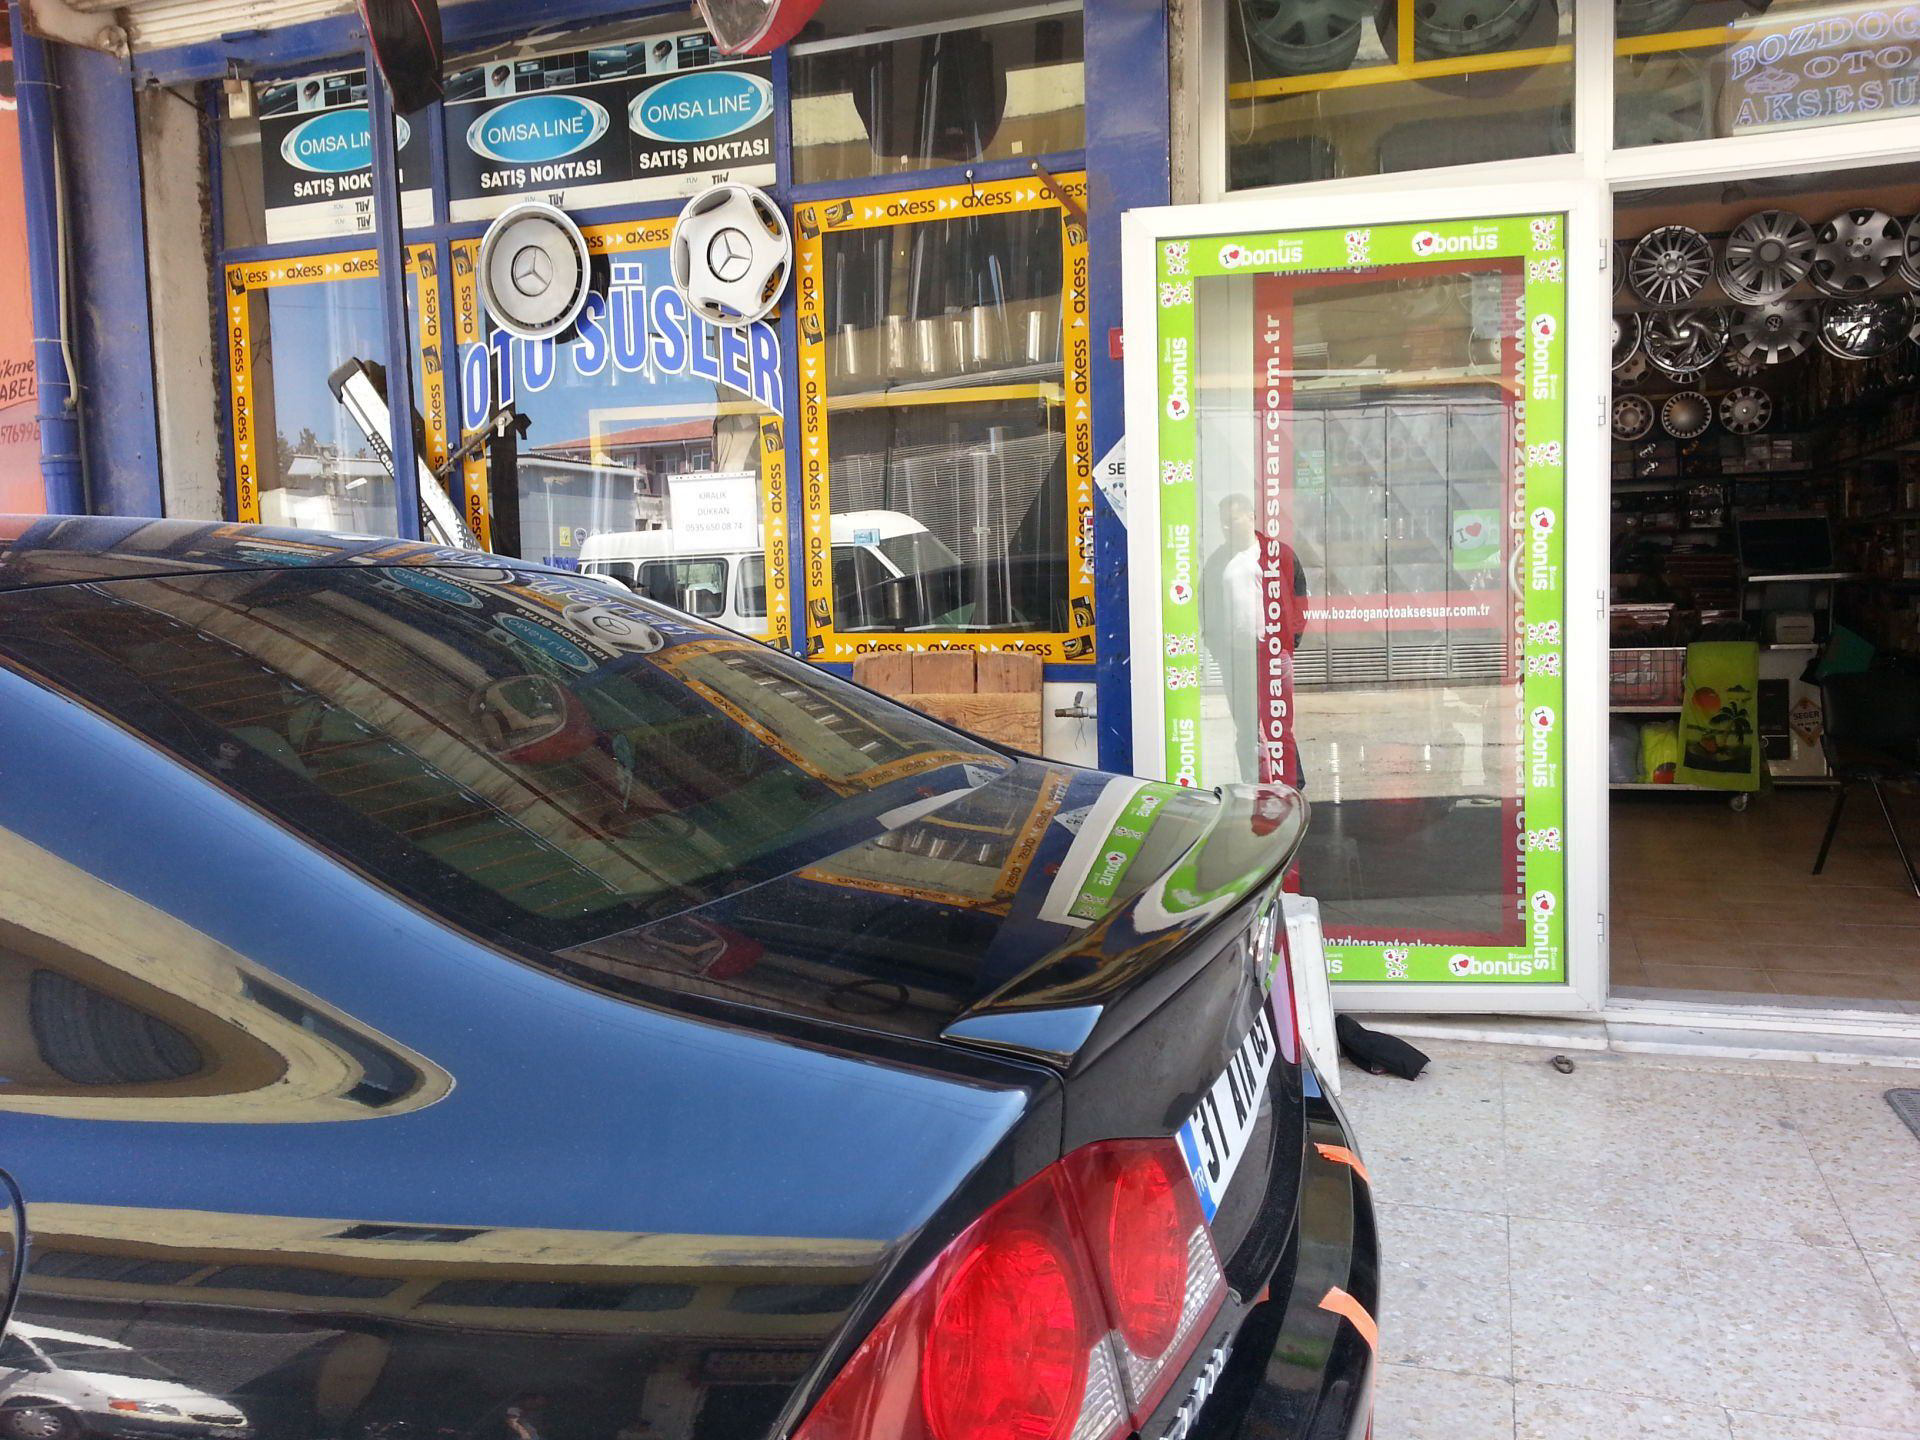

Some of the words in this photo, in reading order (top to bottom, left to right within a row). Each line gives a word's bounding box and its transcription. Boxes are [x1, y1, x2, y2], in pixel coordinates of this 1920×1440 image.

[1803, 46, 1912, 79] OTO
[487, 127, 541, 145] OMSA
[544, 116, 584, 138] LINE
[647, 101, 704, 124] OMSA
[708, 93, 751, 116] LINE
[300, 137, 348, 156] OMSA
[639, 147, 688, 169] SATIŞ
[693, 138, 770, 163] NOKTASI
[293, 177, 335, 197] SATIŞ
[480, 168, 527, 189] SATIŞ
[530, 159, 602, 182] NOKTASI
[886, 200, 936, 218] axess
[961, 189, 1013, 209] axess
[625, 228, 669, 244] axess
[1238, 245, 1304, 267] bonus
[1434, 233, 1499, 253] bonus
[286, 263, 323, 279] axess
[1073, 256, 1087, 313] axess
[426, 288, 437, 336] axess
[461, 285, 473, 334] axess
[233, 326, 244, 373] axess
[462, 326, 557, 431] OTO
[572, 262, 784, 418] SÜSLER
[1074, 339, 1087, 394] axess
[1168, 337, 1188, 400] bonus
[1532, 335, 1554, 400] bonus
[236, 395, 248, 441] axess
[431, 383, 443, 431] axess
[805, 381, 819, 433] axess
[1076, 423, 1089, 477] axess
[240, 464, 252, 510] axess
[771, 463, 782, 513] axess
[808, 460, 821, 511] axess
[774, 539, 785, 590] axess
[811, 537, 823, 587] axess
[1170, 523, 1191, 584] bonus
[1532, 527, 1553, 591] bonus
[1302, 603, 1491, 622] www.bozdoganotoaksesuar.com.tr
[1176, 718, 1195, 779] bonus
[1532, 727, 1553, 788] bonus
[1533, 911, 1554, 970] bonus
[1470, 955, 1533, 976] bonus
